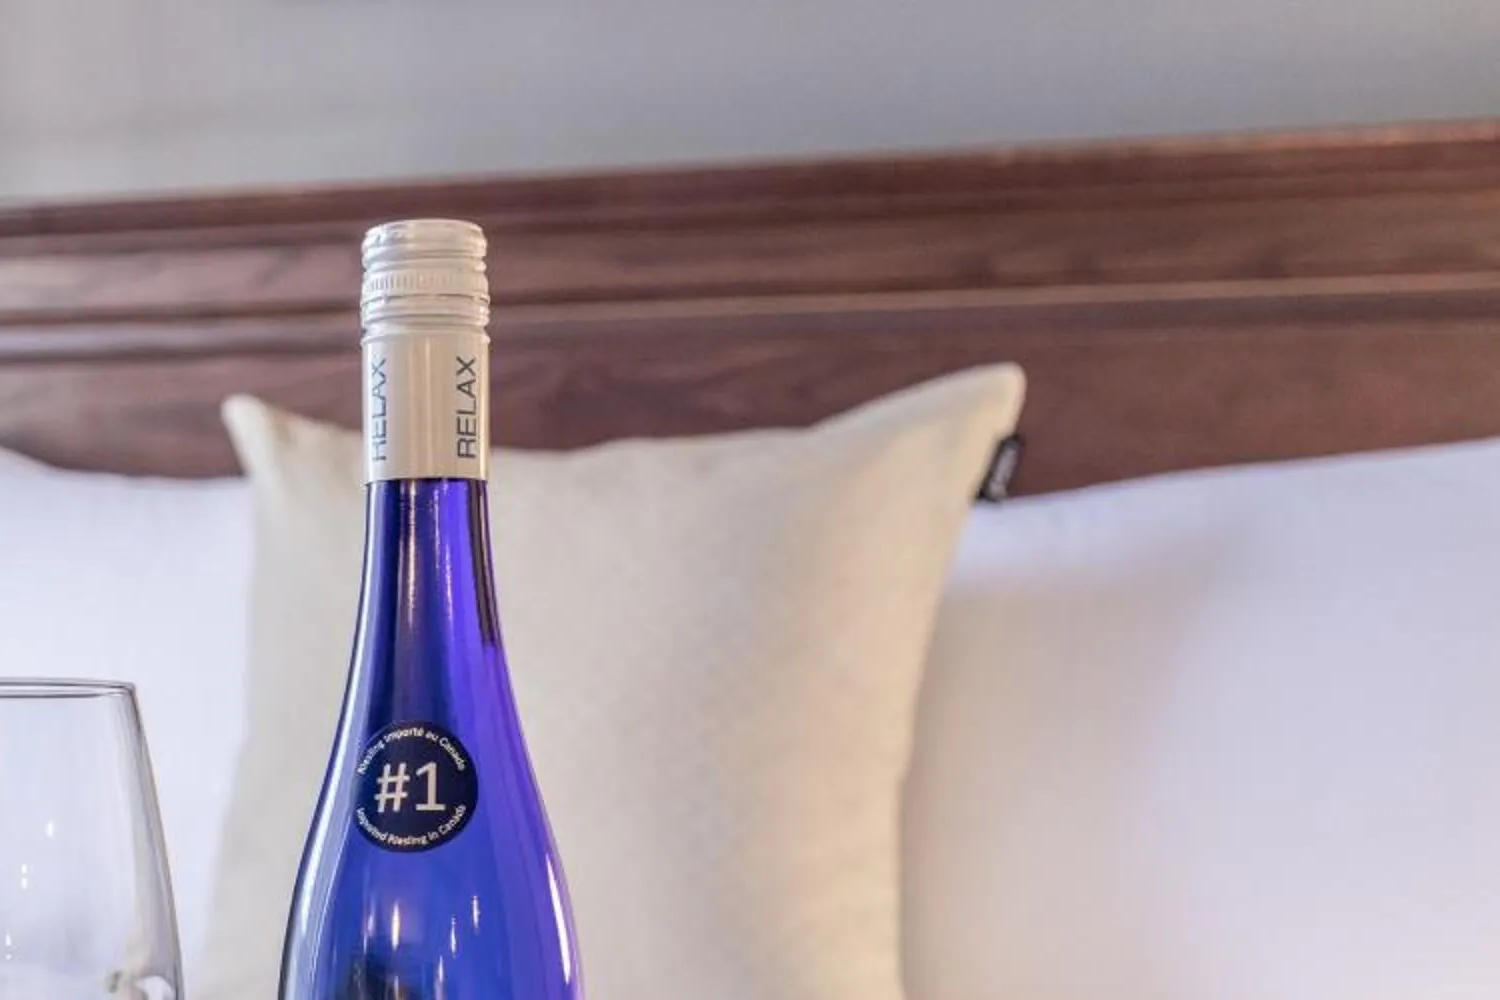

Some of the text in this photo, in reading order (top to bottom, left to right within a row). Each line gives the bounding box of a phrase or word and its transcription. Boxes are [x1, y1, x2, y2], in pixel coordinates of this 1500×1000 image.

[371, 358, 387, 462] RELAX
[455, 355, 477, 460] RELAX
[439, 737, 466, 771] Canada
[374, 761, 446, 813] #1
[387, 834, 429, 846] Riesling
[427, 831, 440, 841] in
[438, 805, 466, 836] Canada
